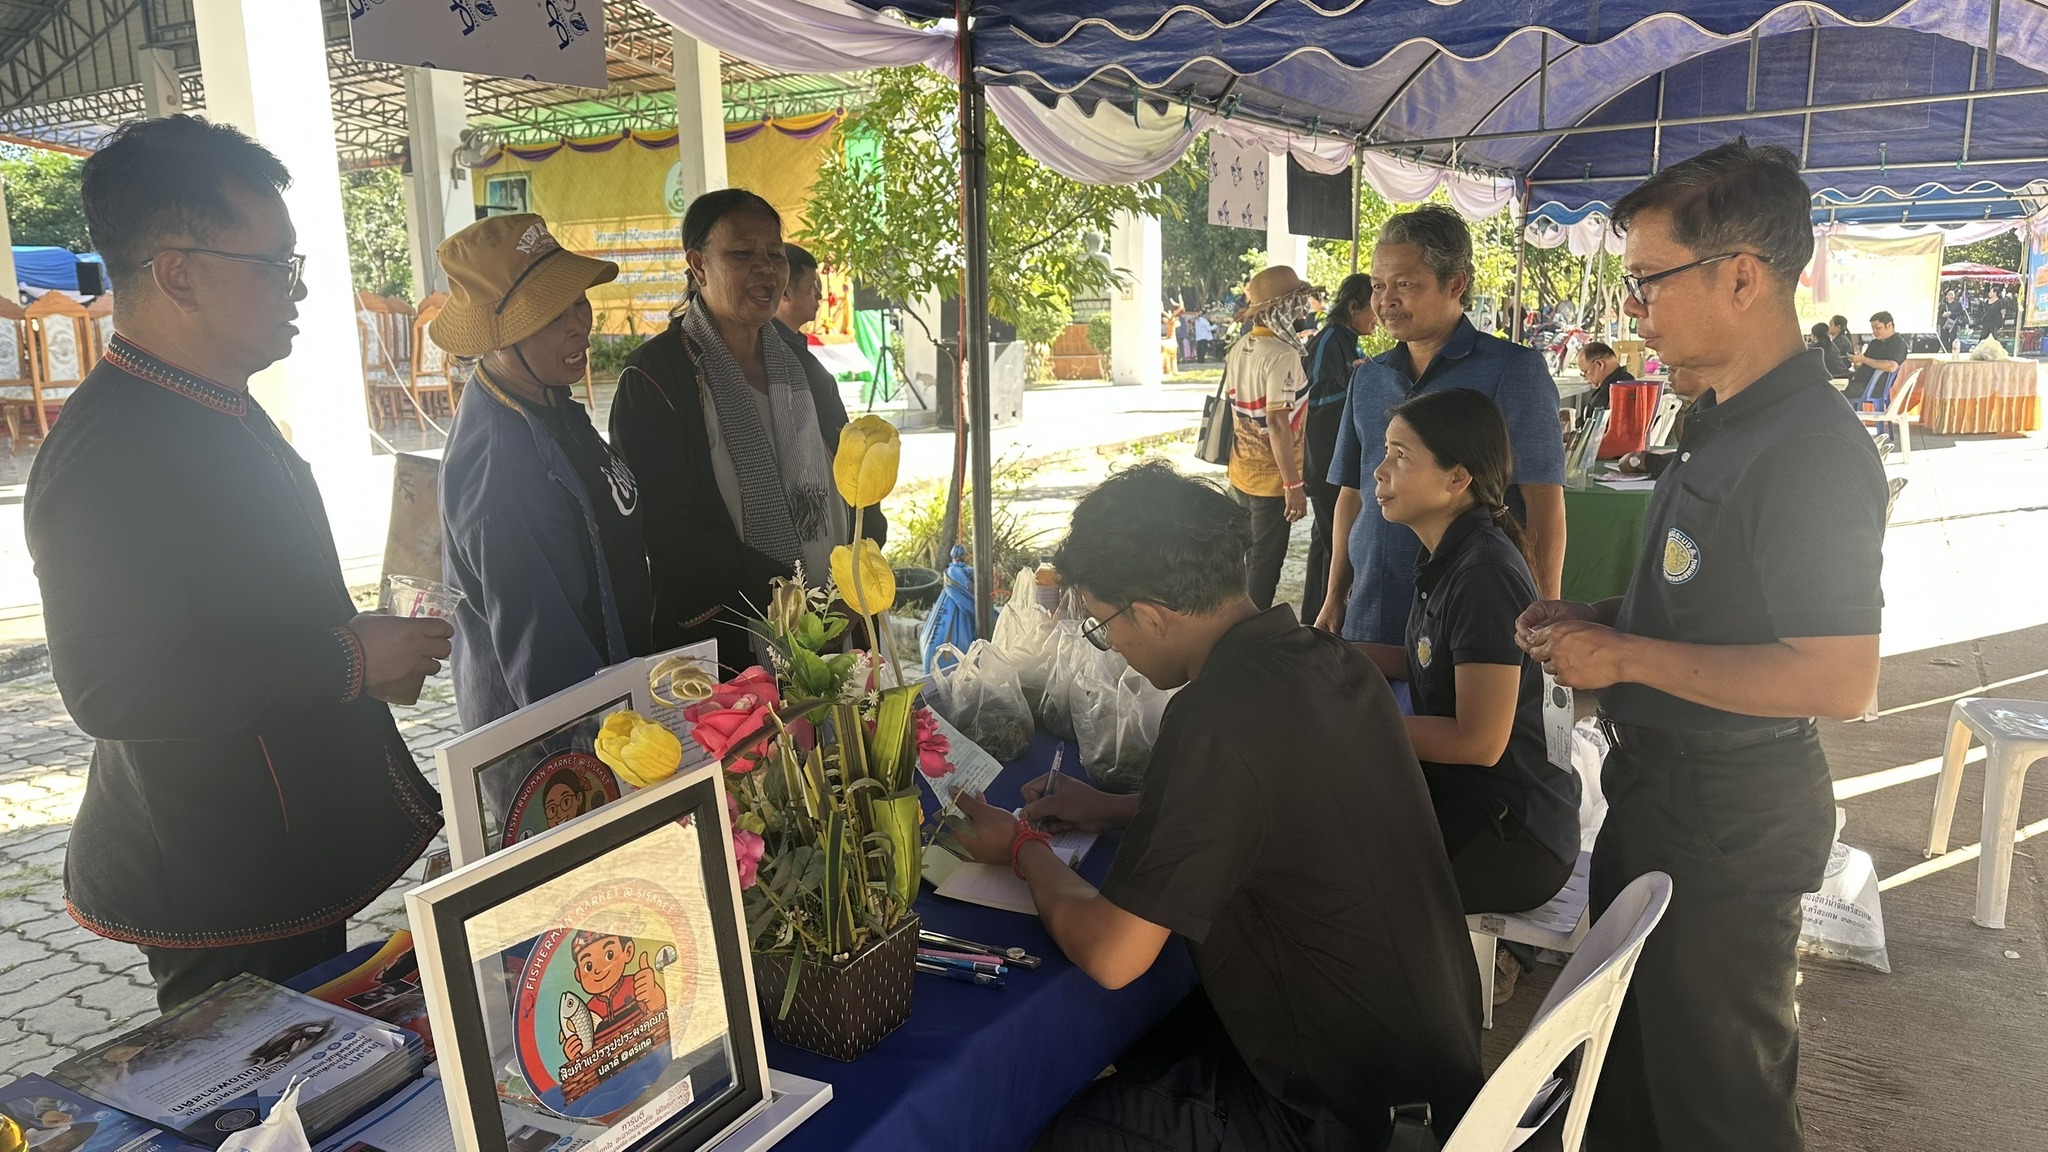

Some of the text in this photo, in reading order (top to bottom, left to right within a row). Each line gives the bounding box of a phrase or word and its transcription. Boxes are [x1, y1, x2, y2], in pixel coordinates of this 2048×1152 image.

[507, 757, 610, 838] FISHERWOMAN MARKET @ SISAKET
[525, 887, 674, 991] FISHERMAN MARKET @ SISAKET
[338, 1042, 386, 1070] โครงการ
[598, 1056, 620, 1076] ปลาดี
[621, 1109, 645, 1131] การันตี
